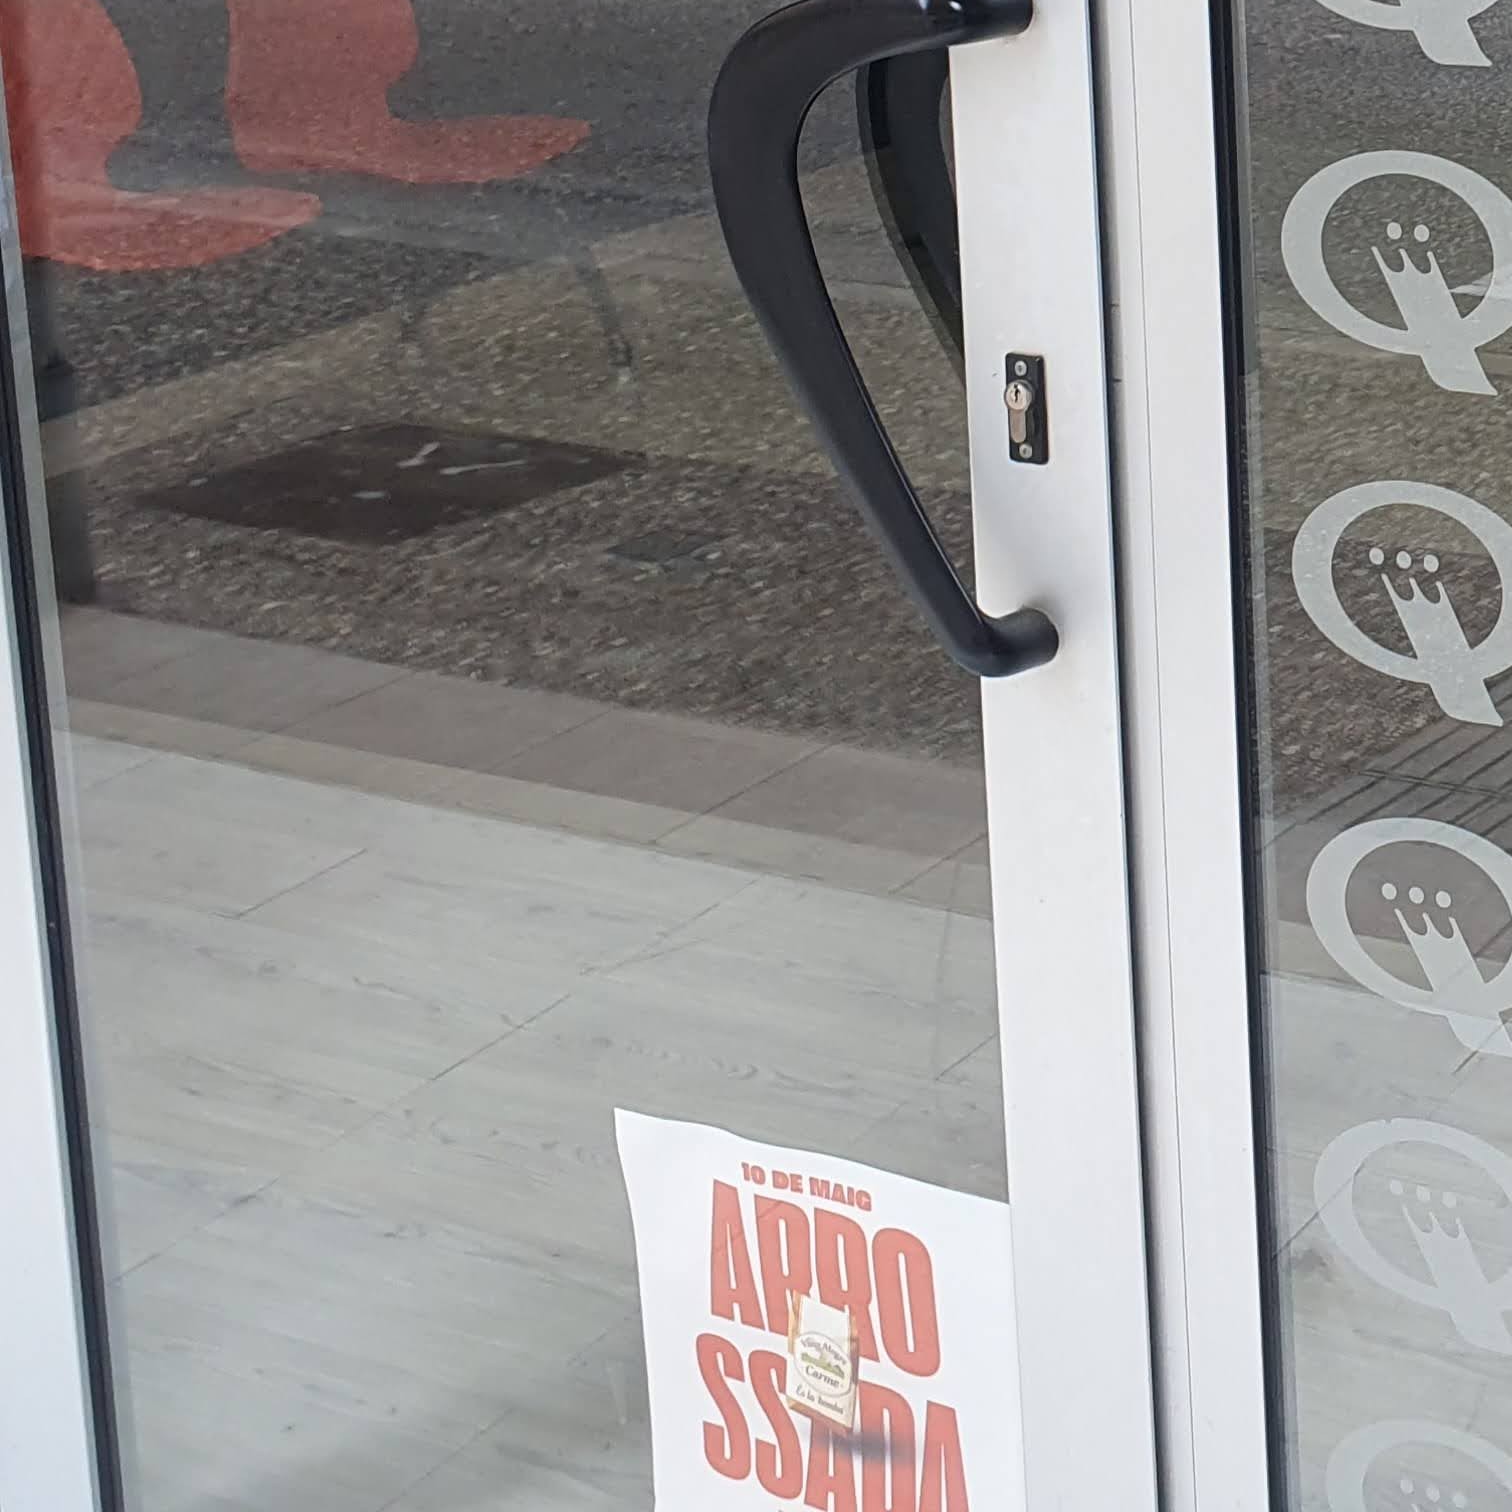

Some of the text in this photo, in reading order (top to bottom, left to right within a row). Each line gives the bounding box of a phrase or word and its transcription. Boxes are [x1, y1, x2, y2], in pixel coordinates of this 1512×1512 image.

[741, 1162, 872, 1211] 10 DE MAIG
[806, 1365, 840, 1388] Carme
